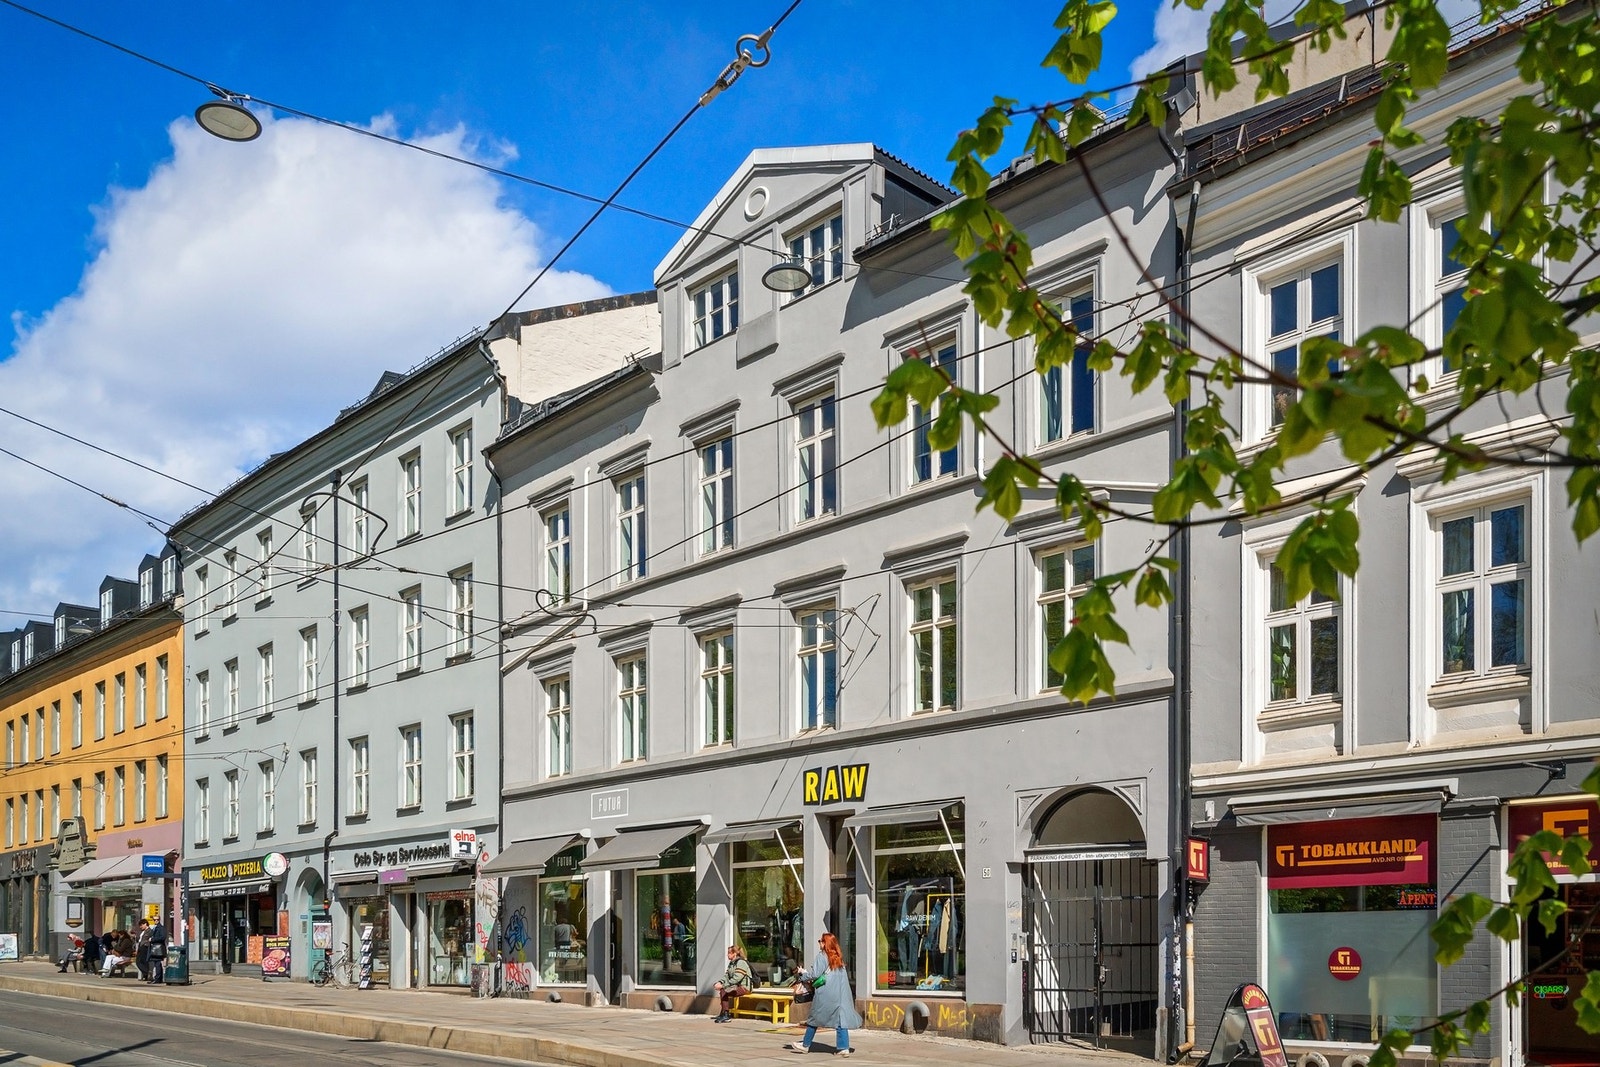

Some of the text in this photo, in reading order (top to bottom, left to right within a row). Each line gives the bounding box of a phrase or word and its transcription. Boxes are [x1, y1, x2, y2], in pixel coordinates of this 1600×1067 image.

[803, 763, 870, 806] RAW
[598, 795, 621, 813] FUTUR
[454, 830, 476, 842] elna
[354, 852, 371, 868] Oslo
[387, 847, 398, 866] og
[1300, 839, 1417, 859] TOBAKKLAND
[557, 855, 573, 867] FUTUR
[201, 865, 228, 880] PALAZZO
[233, 861, 262, 877] PIZZERIA
[1400, 889, 1435, 906] ÅPENT
[1534, 985, 1564, 994] CIGARS
